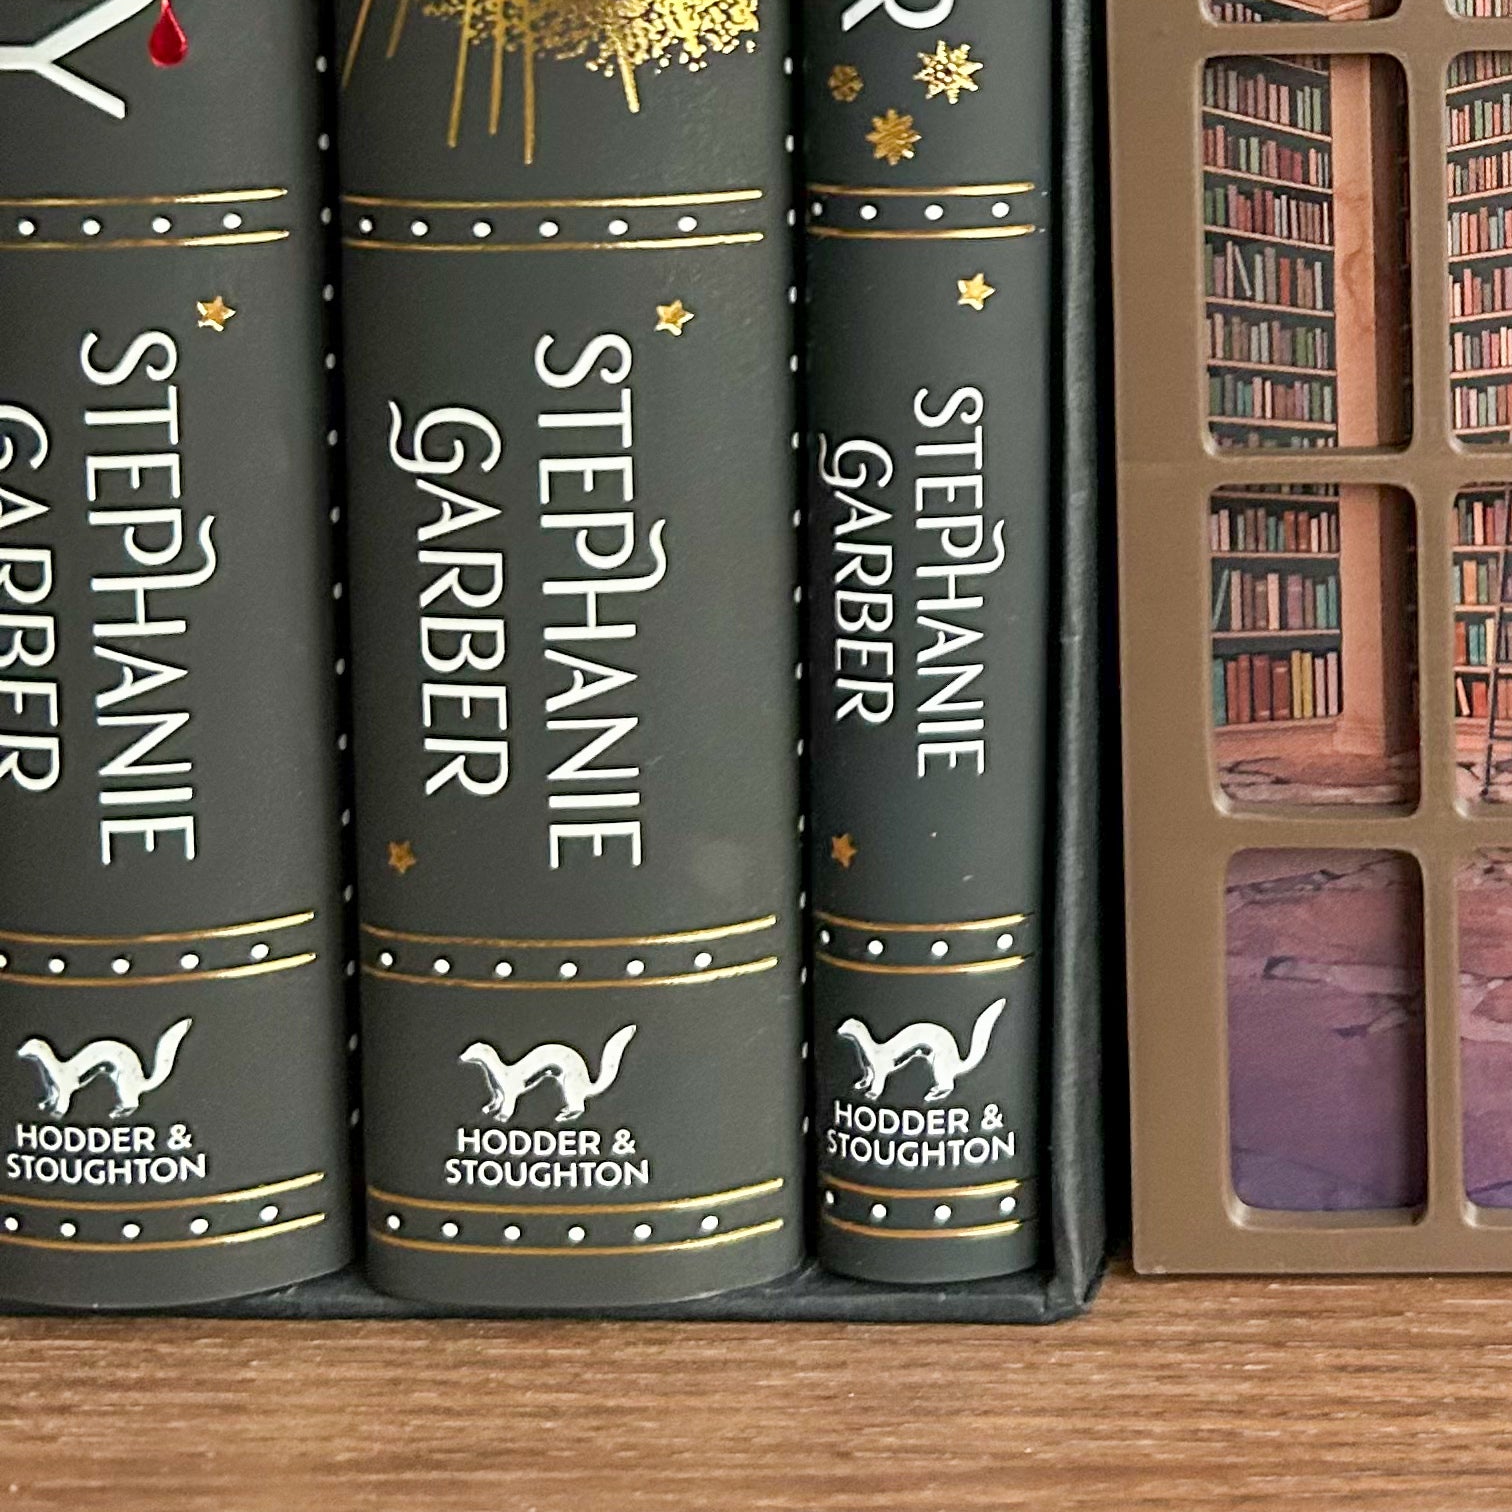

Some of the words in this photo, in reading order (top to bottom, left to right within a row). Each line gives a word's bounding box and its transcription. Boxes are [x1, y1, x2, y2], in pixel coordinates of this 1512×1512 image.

[818, 432, 895, 723] GARBER
[913, 387, 1005, 778] STEPHANIE
[80, 330, 218, 866] STEPHANIE
[388, 400, 509, 796] GARBER
[534, 334, 667, 869] STEPHANIE
[833, 1099, 971, 1136] HODDER
[980, 1103, 1005, 1131] &
[16, 1124, 157, 1153] HODDER
[167, 1123, 193, 1152] &
[456, 1127, 601, 1157] HODDER
[611, 1127, 637, 1157] &
[826, 1129, 1016, 1168] STOUGHTON
[6, 1153, 207, 1185] STOUGHTON
[445, 1158, 650, 1189] STOUGHTON
